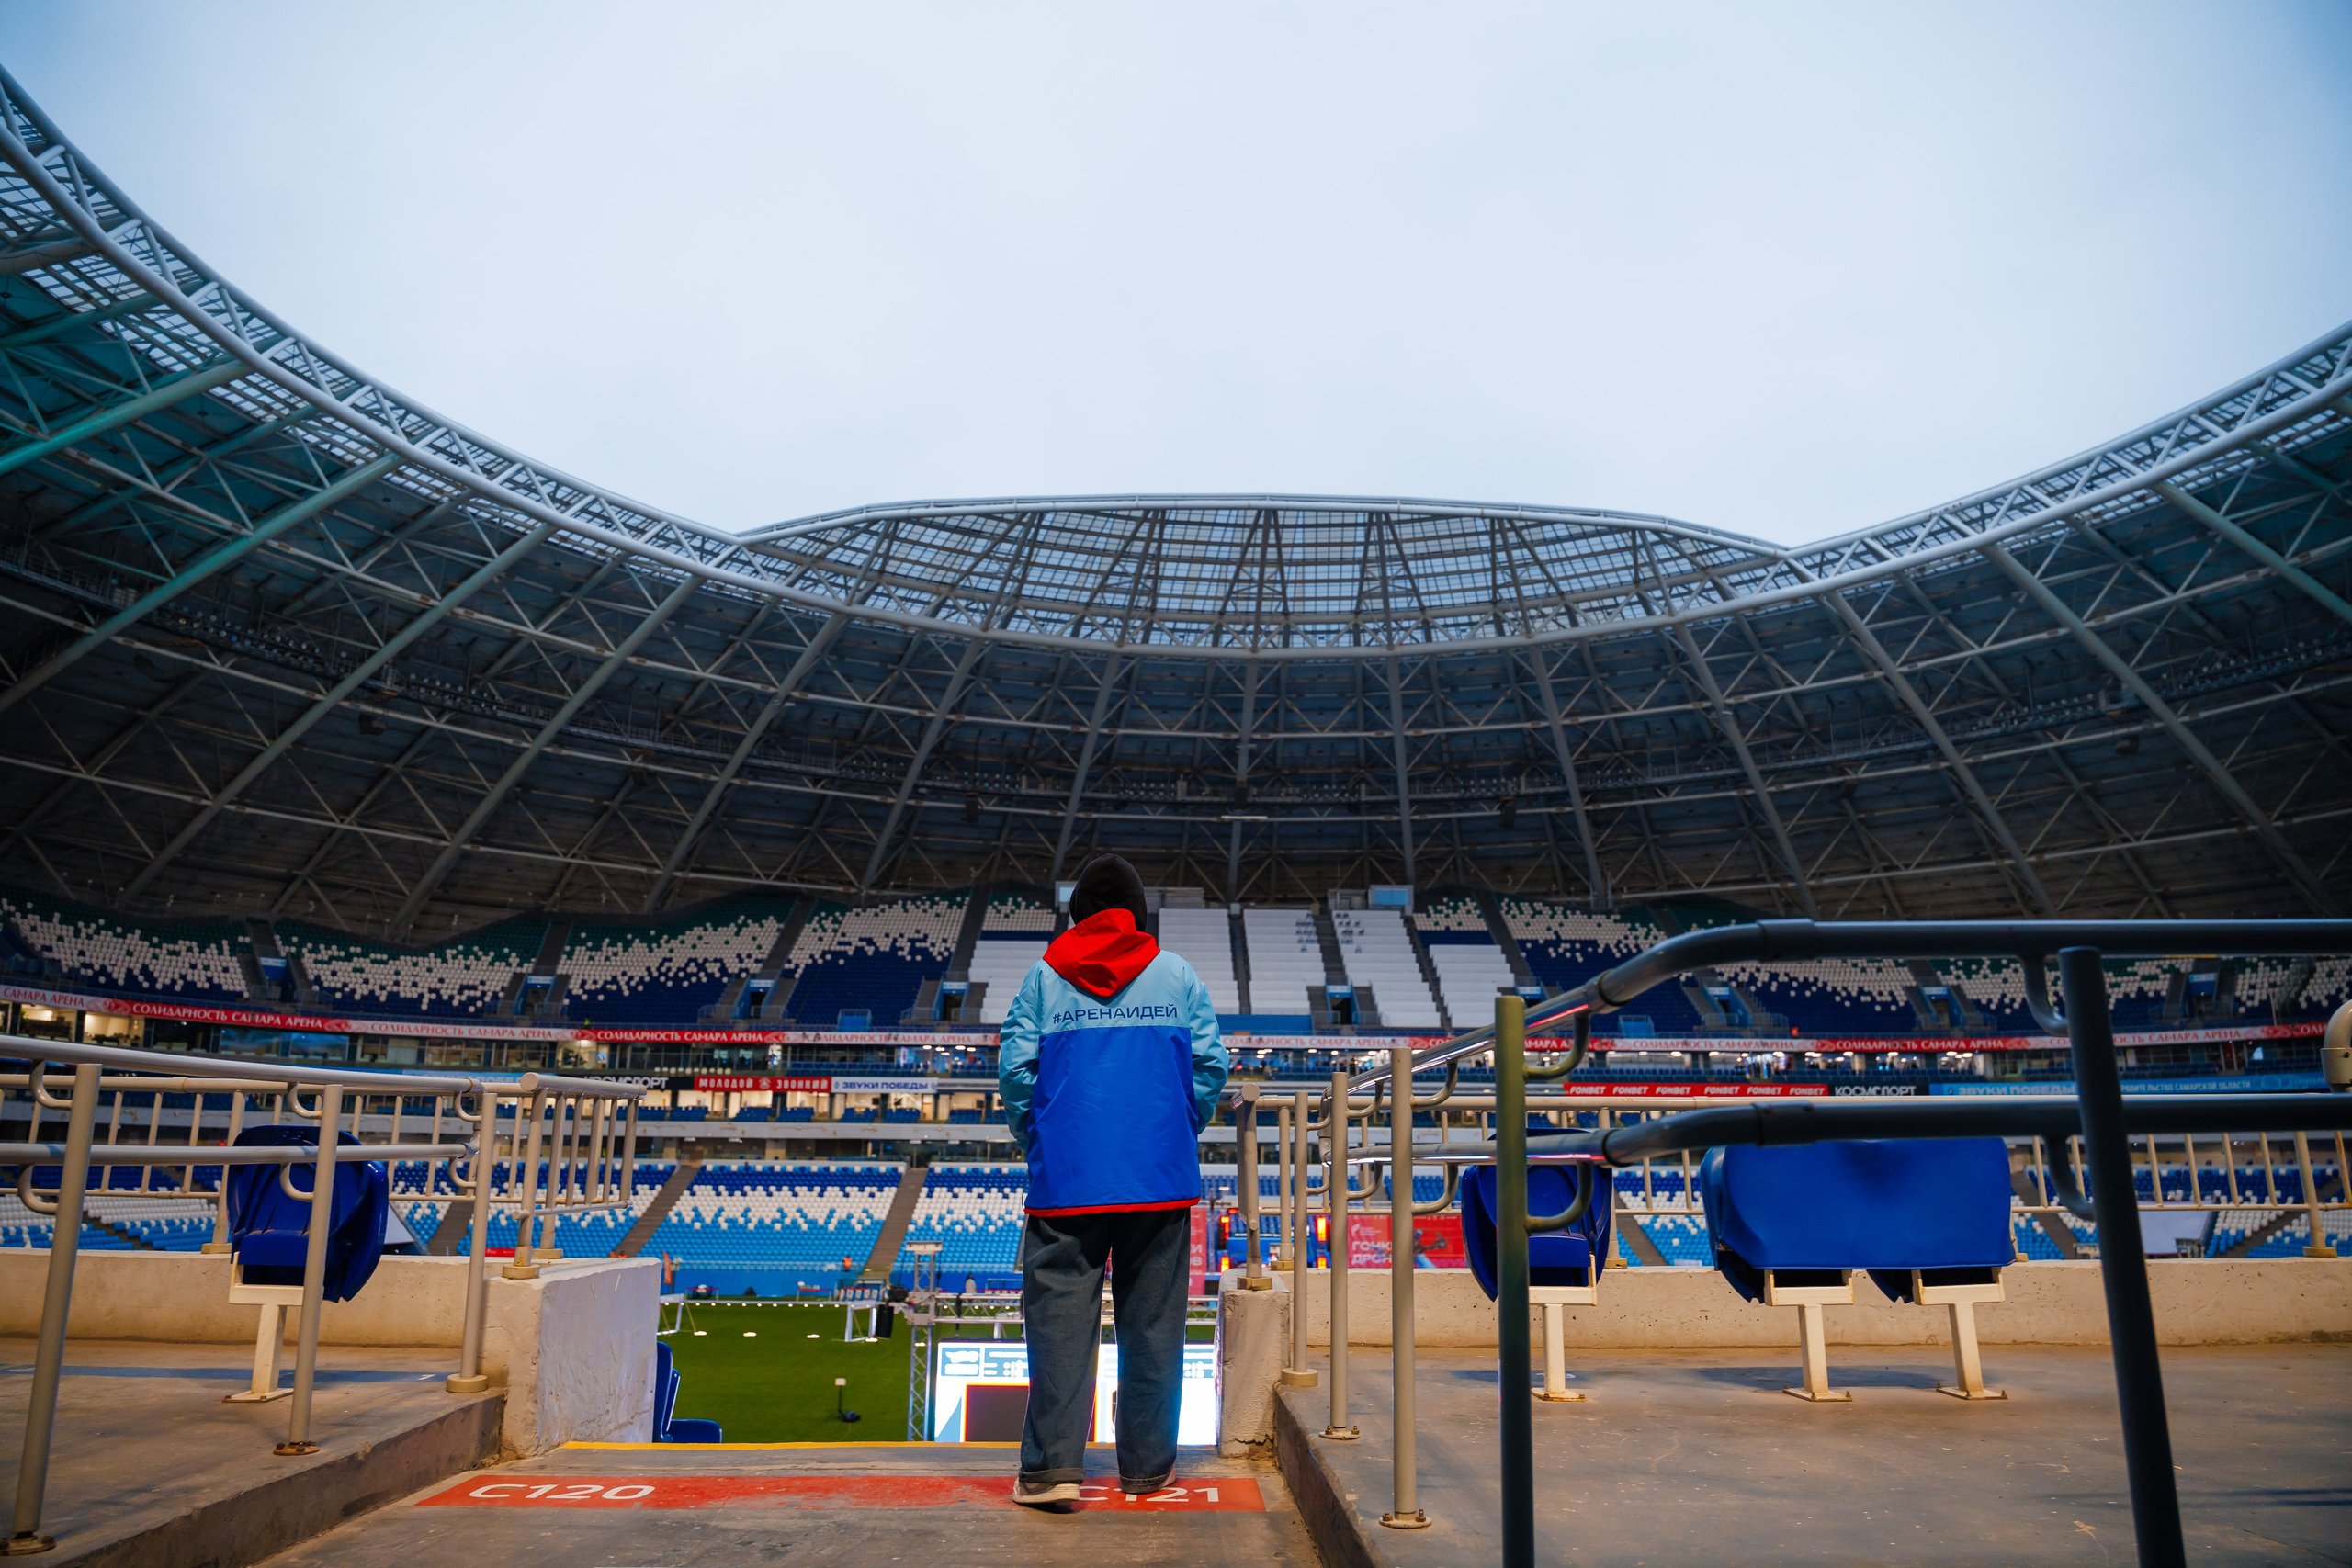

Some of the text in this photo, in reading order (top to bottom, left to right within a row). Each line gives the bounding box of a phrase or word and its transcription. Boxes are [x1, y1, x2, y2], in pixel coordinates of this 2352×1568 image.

[3, 987, 85, 1008] САМАРА АРЕНА
[132, 1002, 228, 1021] СОЛИДАРНОСТЬ
[285, 1017, 322, 1029] АРЕНА
[1051, 1003, 1179, 1024] #АРЕНАИДЕЙ
[370, 1022, 552, 1039] СОЛИДАРНОСТЬ САМАРА АРЕНА
[2148, 1032, 2199, 1043] САМАРА
[2204, 1029, 2242, 1040] АРЕНА
[597, 1031, 763, 1043] СОЛИДАРНОСТЬ САМАРА АРЕНА
[941, 1034, 972, 1043] АРЕНА
[1309, 1037, 1351, 1046] САМАРА
[1355, 1037, 1387, 1047] АРЕНА
[1718, 1040, 1761, 1050] САМАРА
[1836, 1038, 2004, 1051] СОЛИДАРНОСТЬ САМАРА АРЕНА
[698, 1077, 829, 1089] МОЛОДОЙ ЗВОНКИЙ
[842, 1081, 929, 1091] ЗВУКИ ПОБЕДЫ
[2120, 1084, 2174, 1093] РАВИТЕЛЬСТВО
[1569, 1086, 1826, 1096] FONBET FONBET FONBET FONBET FONBET FONBET
[1958, 1084, 2076, 1096] ЗВУКИ ПОБЕДЫ
